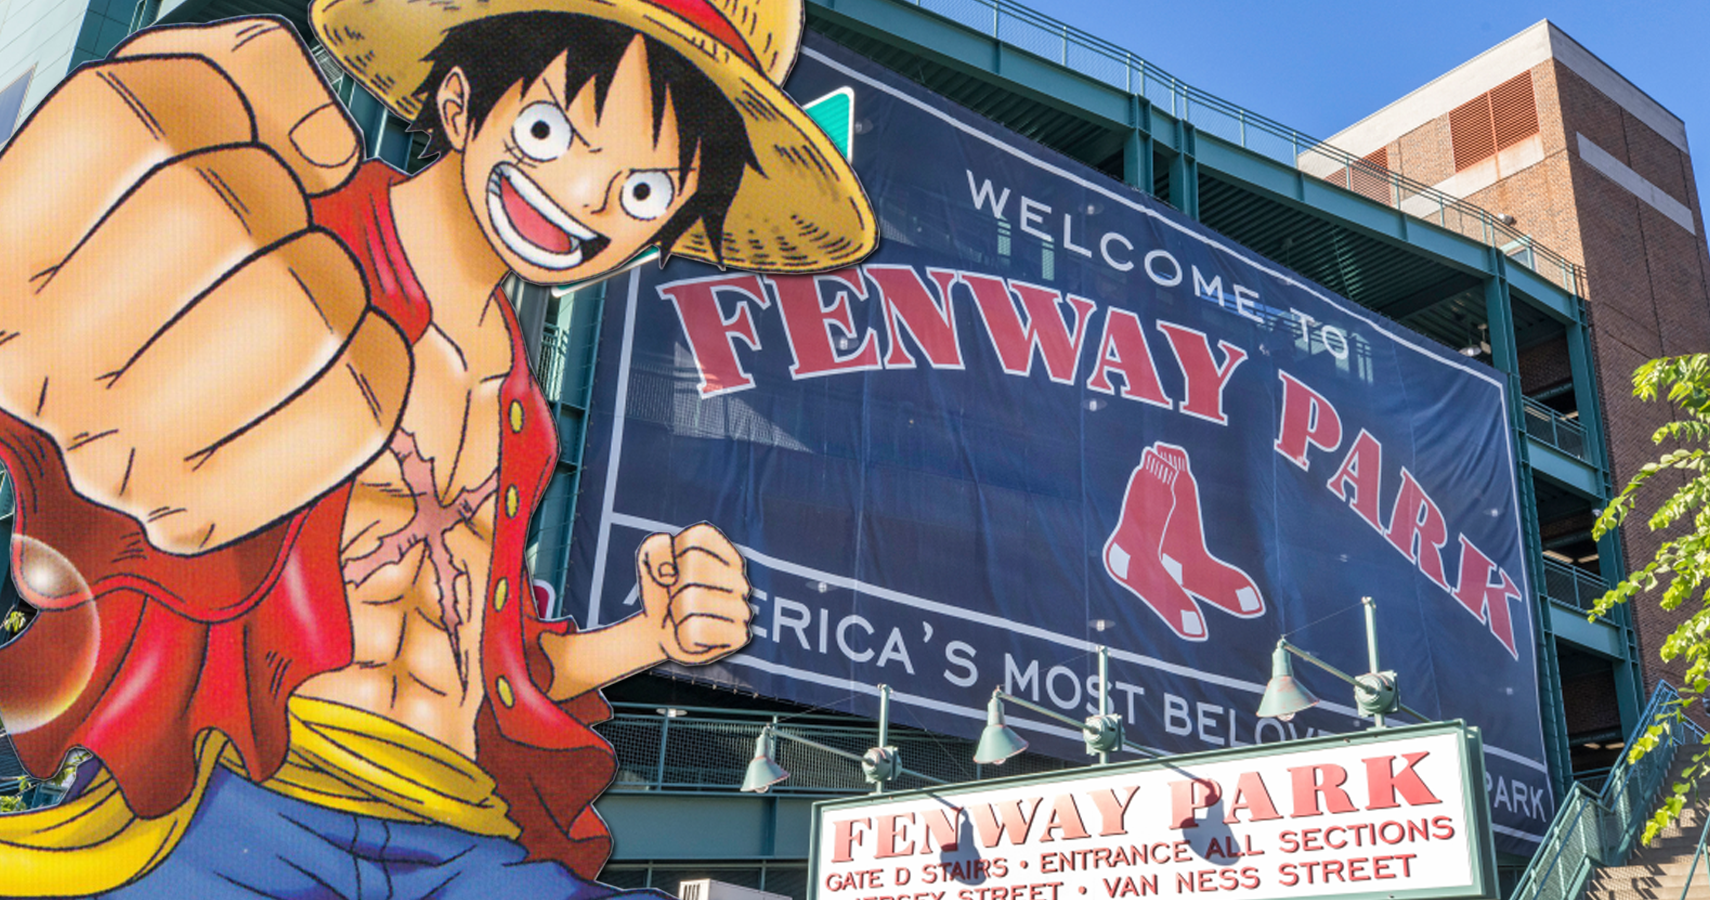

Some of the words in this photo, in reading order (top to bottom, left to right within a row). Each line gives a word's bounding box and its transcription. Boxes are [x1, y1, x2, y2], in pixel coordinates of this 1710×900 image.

[966, 169, 1264, 322] WELCOME
[1289, 307, 1350, 360] TO
[655, 263, 1247, 426] FENWAY
[1273, 368, 1522, 662] PARK
[1004, 653, 1145, 725] MOST
[825, 868, 884, 892] GATE
[894, 867, 911, 886] D
[921, 856, 1010, 884] STAIRS
[1040, 840, 1193, 874] ENTRANCE
[1204, 834, 1265, 860] ALL
[1278, 815, 1456, 854] SECTIONS
[831, 785, 1141, 863] FENWAY
[1168, 751, 1443, 831] PARK
[1103, 873, 1158, 900] VAN
[1176, 867, 1261, 894] NESS
[1277, 853, 1418, 887] STREET
